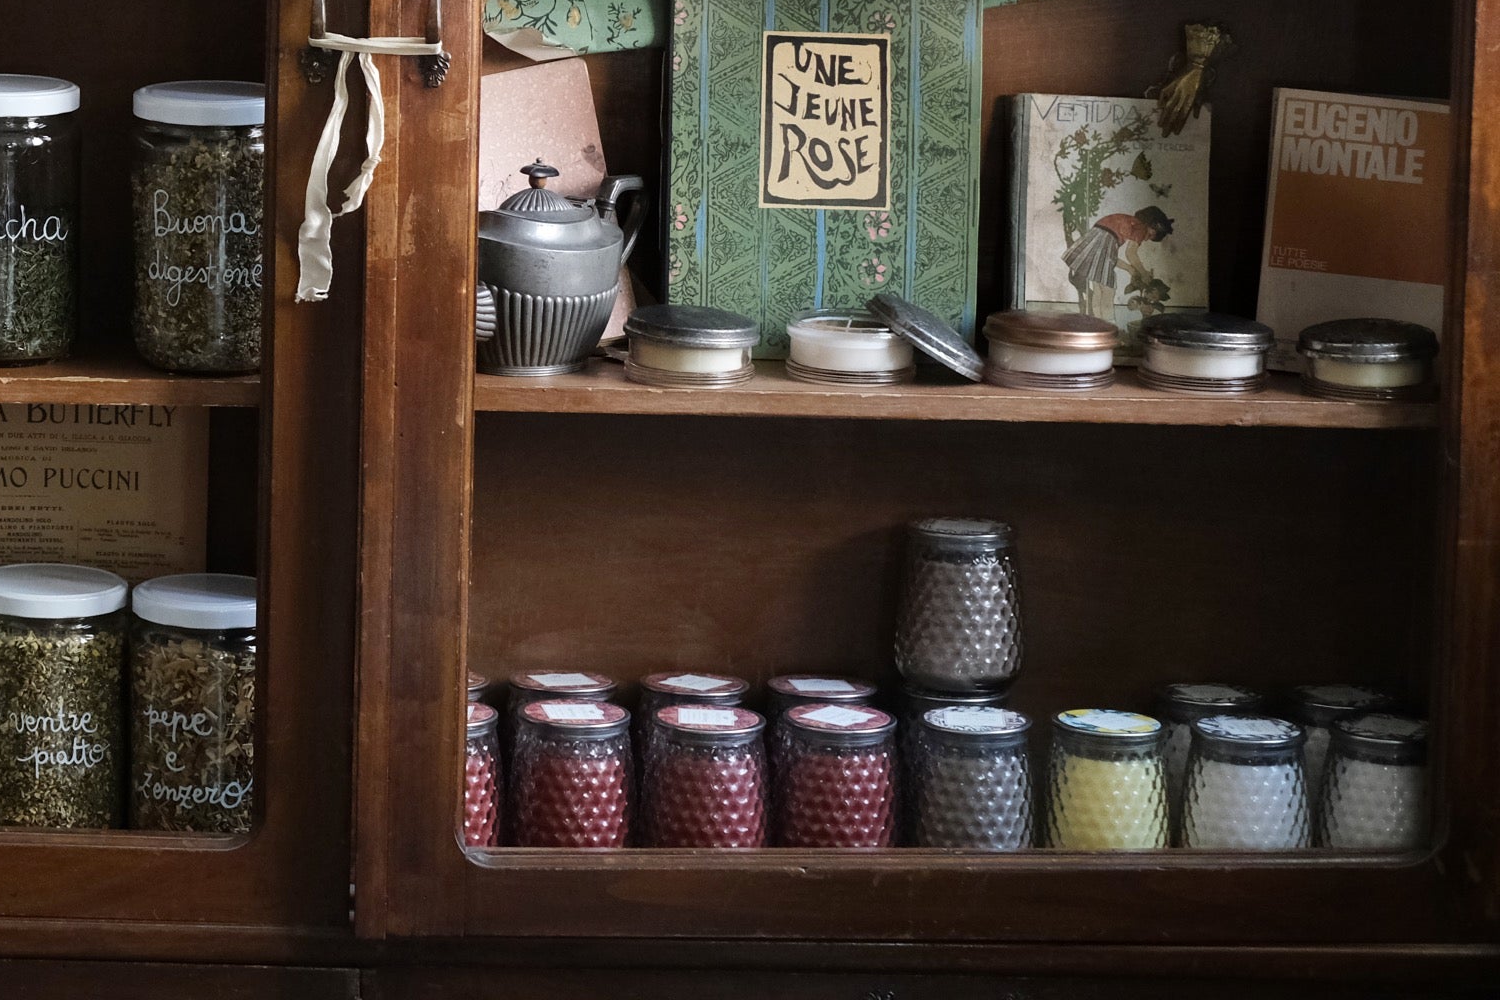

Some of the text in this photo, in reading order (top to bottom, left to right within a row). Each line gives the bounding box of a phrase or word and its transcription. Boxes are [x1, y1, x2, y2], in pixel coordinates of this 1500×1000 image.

[792, 42, 865, 87] UNE
[773, 72, 879, 132] JEUNE
[1284, 99, 1419, 147] EUGENIO
[777, 122, 876, 191] ROSE
[1279, 136, 1425, 185] MONTALE
[150, 187, 259, 239] Buona
[1270, 255, 1329, 272] LE POESIE
[1272, 245, 1309, 259] TUTTE
[42, 467, 140, 492] PUCCINI
[8, 699, 101, 735] ventre
[144, 705, 214, 743] pepe
[16, 736, 111, 778] piatto
[165, 750, 186, 773] e
